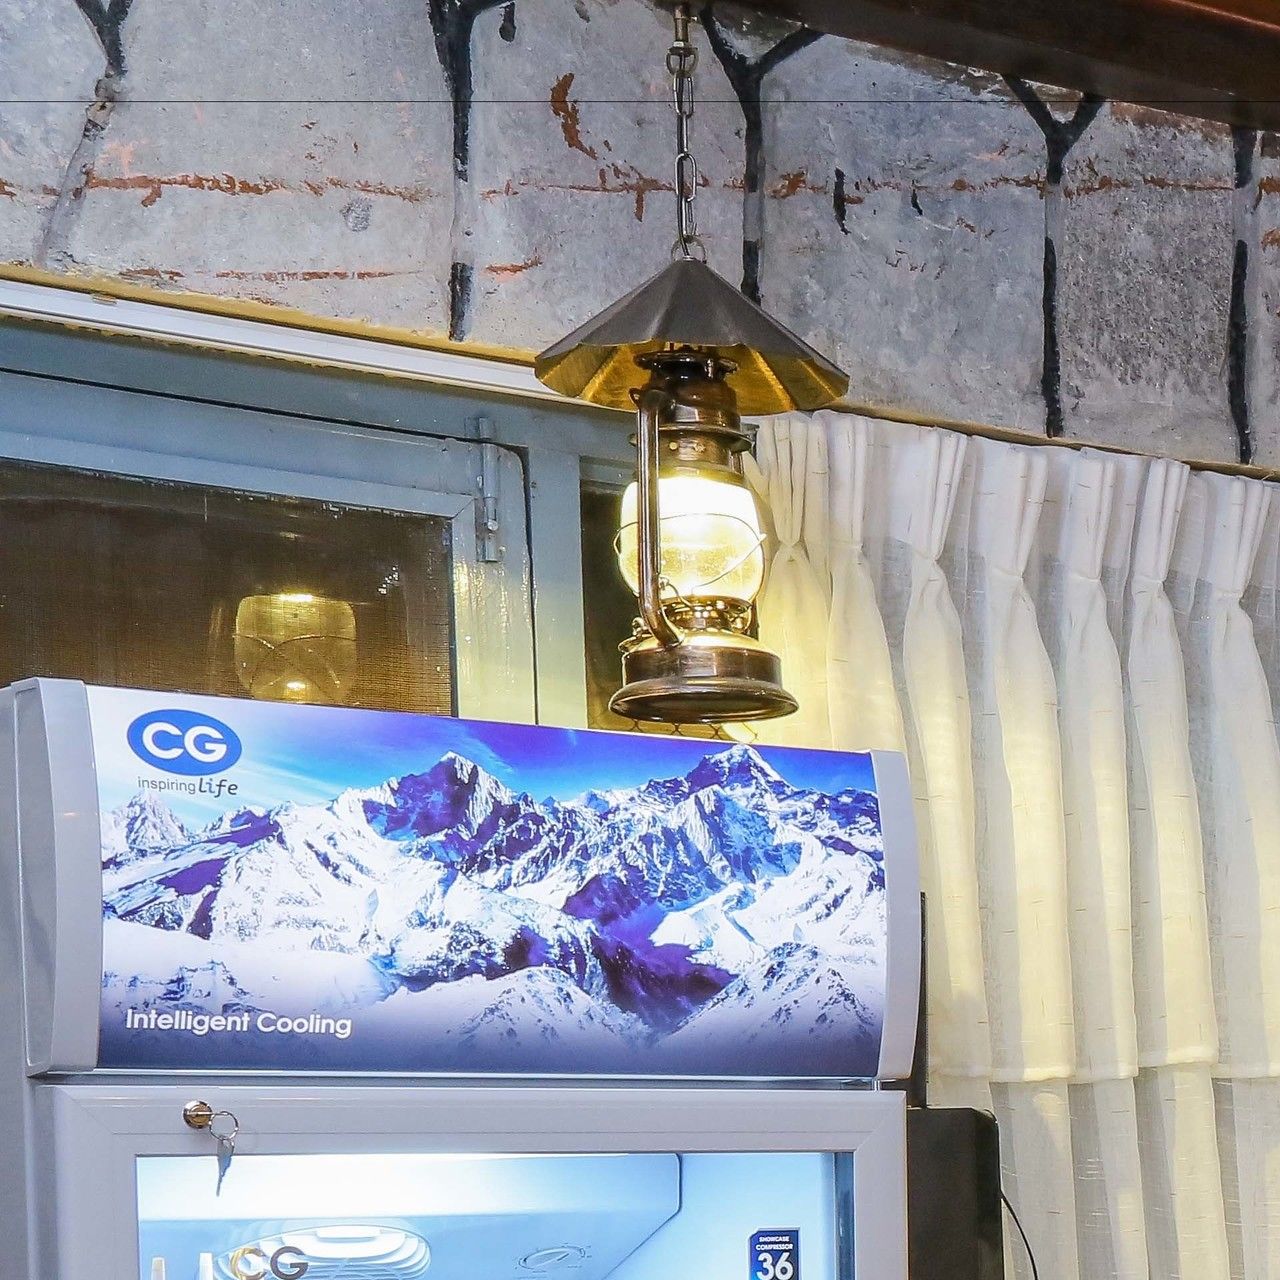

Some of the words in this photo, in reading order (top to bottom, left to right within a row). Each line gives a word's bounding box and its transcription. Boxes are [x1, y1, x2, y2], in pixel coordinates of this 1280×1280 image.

[142, 721, 227, 762] CG
[138, 776, 195, 794] inspiring
[199, 777, 238, 798] life
[126, 1009, 250, 1035] Intelligent
[256, 1013, 352, 1039] Cooling
[755, 1243, 793, 1251] COMPRESSOR
[757, 1252, 794, 1280] 36
